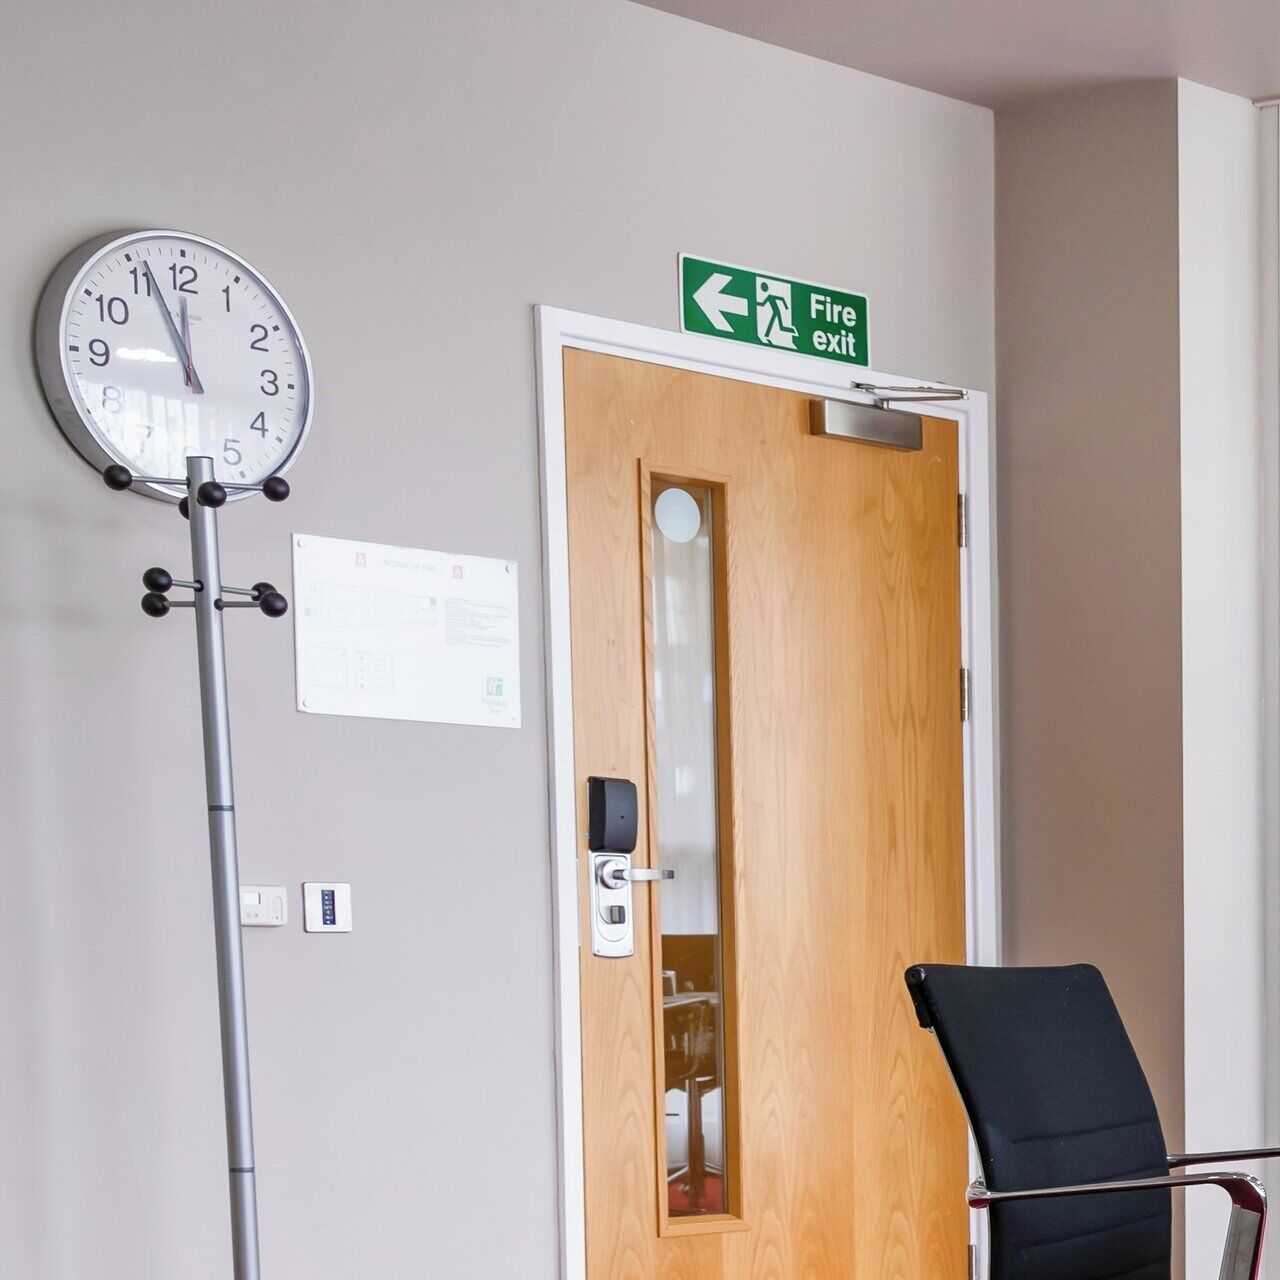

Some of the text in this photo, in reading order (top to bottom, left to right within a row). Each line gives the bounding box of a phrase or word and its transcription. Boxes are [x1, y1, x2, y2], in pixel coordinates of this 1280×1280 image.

[129, 266, 152, 297] 11
[169, 262, 198, 295] 12
[95, 294, 129, 325] 10
[222, 285, 231, 312] 1
[810, 293, 857, 327] Fire
[250, 324, 269, 352] 2
[812, 330, 857, 357] exit
[88, 339, 110, 367] 9
[260, 369, 279, 396] 3
[102, 385, 124, 414] 8
[250, 411, 268, 438] 4
[223, 438, 242, 466] 5
